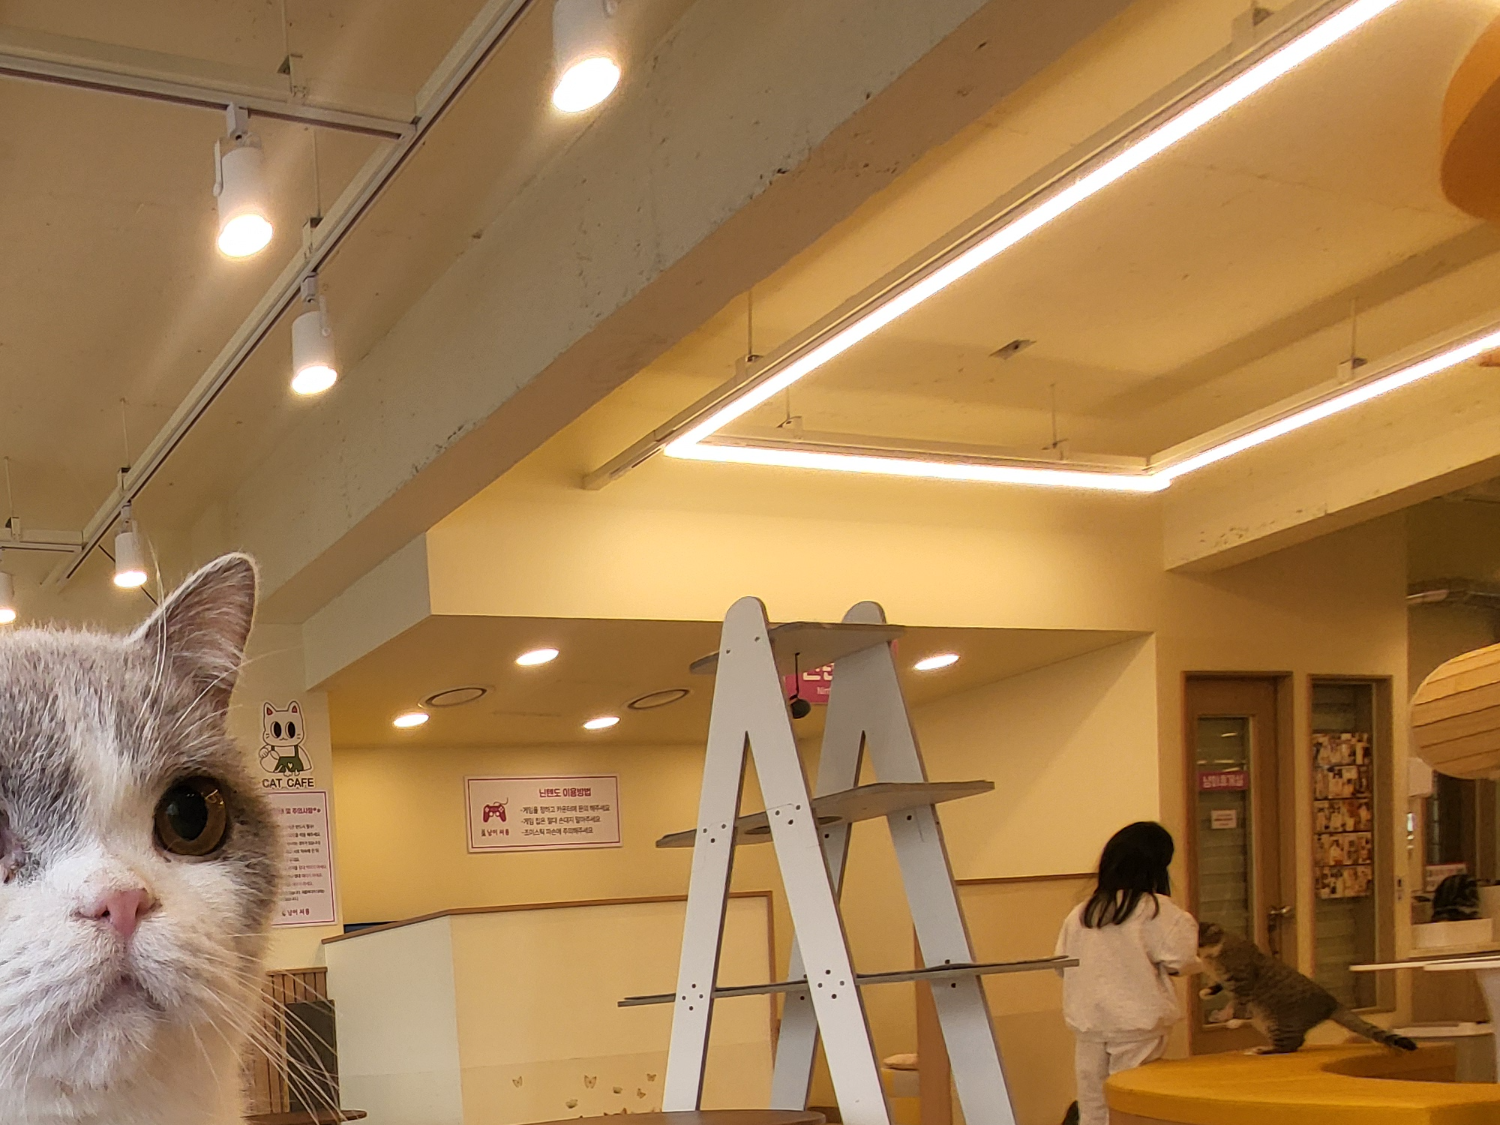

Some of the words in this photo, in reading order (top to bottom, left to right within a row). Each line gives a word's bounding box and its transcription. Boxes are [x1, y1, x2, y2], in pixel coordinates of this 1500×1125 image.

[262, 779, 282, 788] CAT
[287, 778, 314, 788] CAFE
[539, 788, 562, 798] 닌텐도
[563, 787, 592, 797] 이용방법
